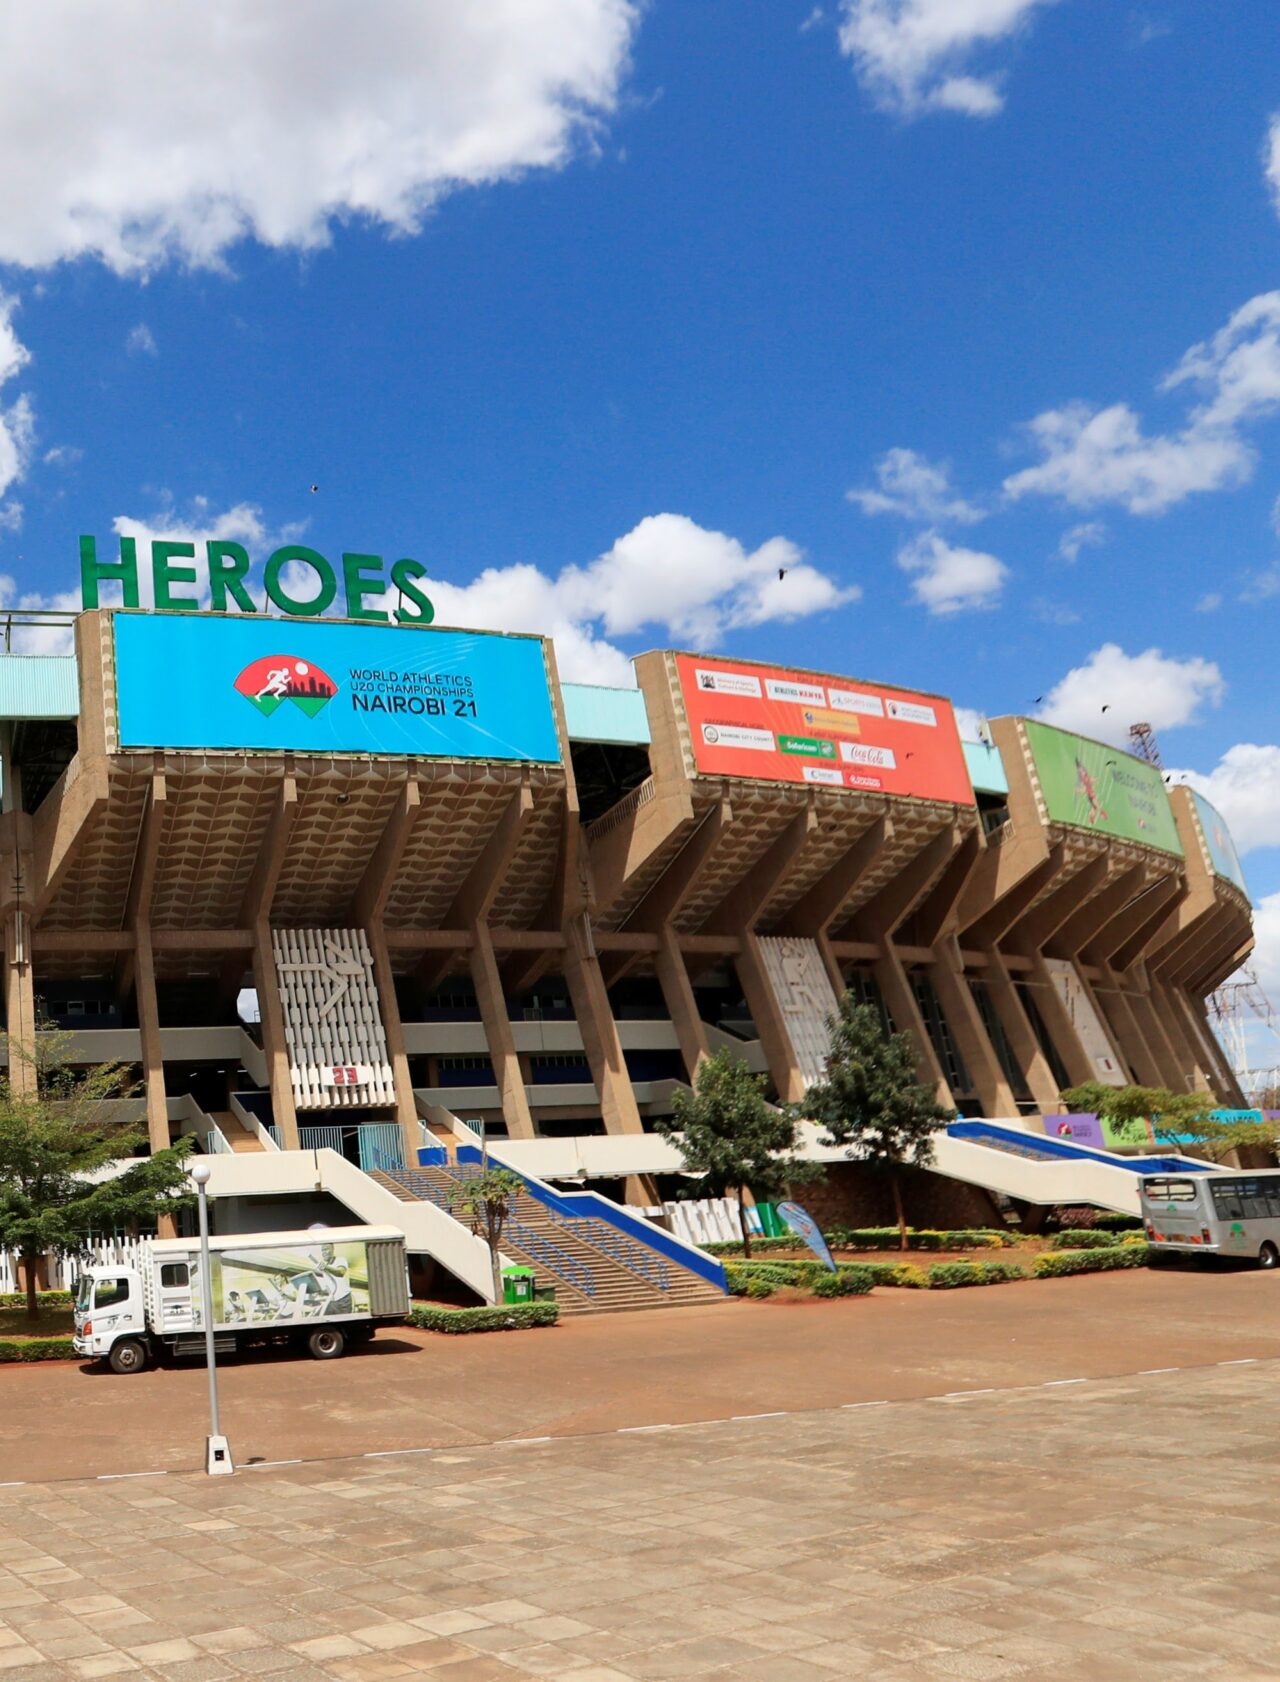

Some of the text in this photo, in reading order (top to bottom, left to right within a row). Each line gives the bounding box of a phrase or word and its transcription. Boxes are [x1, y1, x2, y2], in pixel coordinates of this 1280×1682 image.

[79, 535, 434, 624] HEROES
[349, 668, 473, 687] WORLD ATHLETICS
[350, 681, 474, 698] U20 CHAMPIONSHIPS
[351, 693, 477, 718] NAIROBI 21
[332, 1067, 359, 1084] 23
